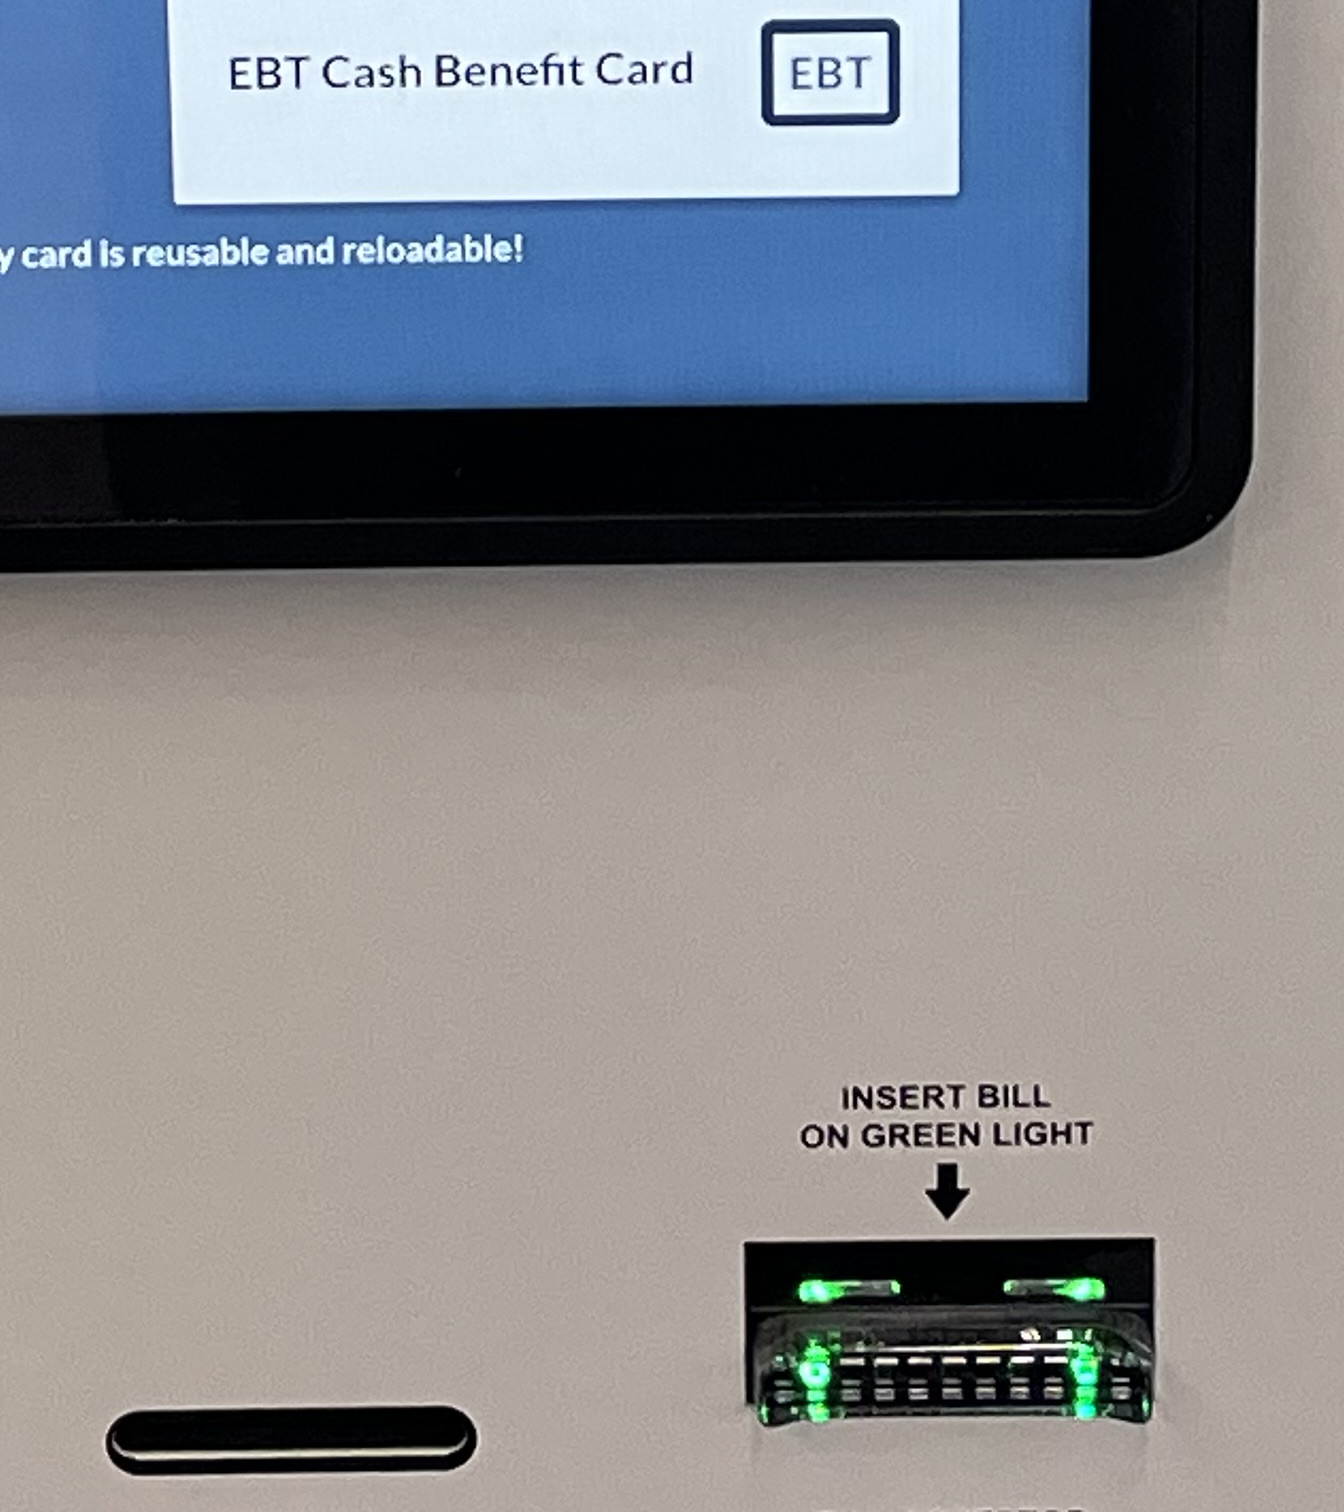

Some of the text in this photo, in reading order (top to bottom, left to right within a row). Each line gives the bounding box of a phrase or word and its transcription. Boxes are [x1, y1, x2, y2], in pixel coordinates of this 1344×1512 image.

[229, 50, 694, 91] EBT Cash Benefit Card
[790, 55, 870, 91] EBT
[20, 237, 93, 271] card
[98, 237, 127, 270] is
[131, 235, 271, 269] reusable
[275, 234, 336, 267] and
[341, 232, 524, 267] reloadable!
[841, 1083, 1052, 1111] INSERT BILL
[799, 1120, 1095, 1150] ON GREEN LIGHT
